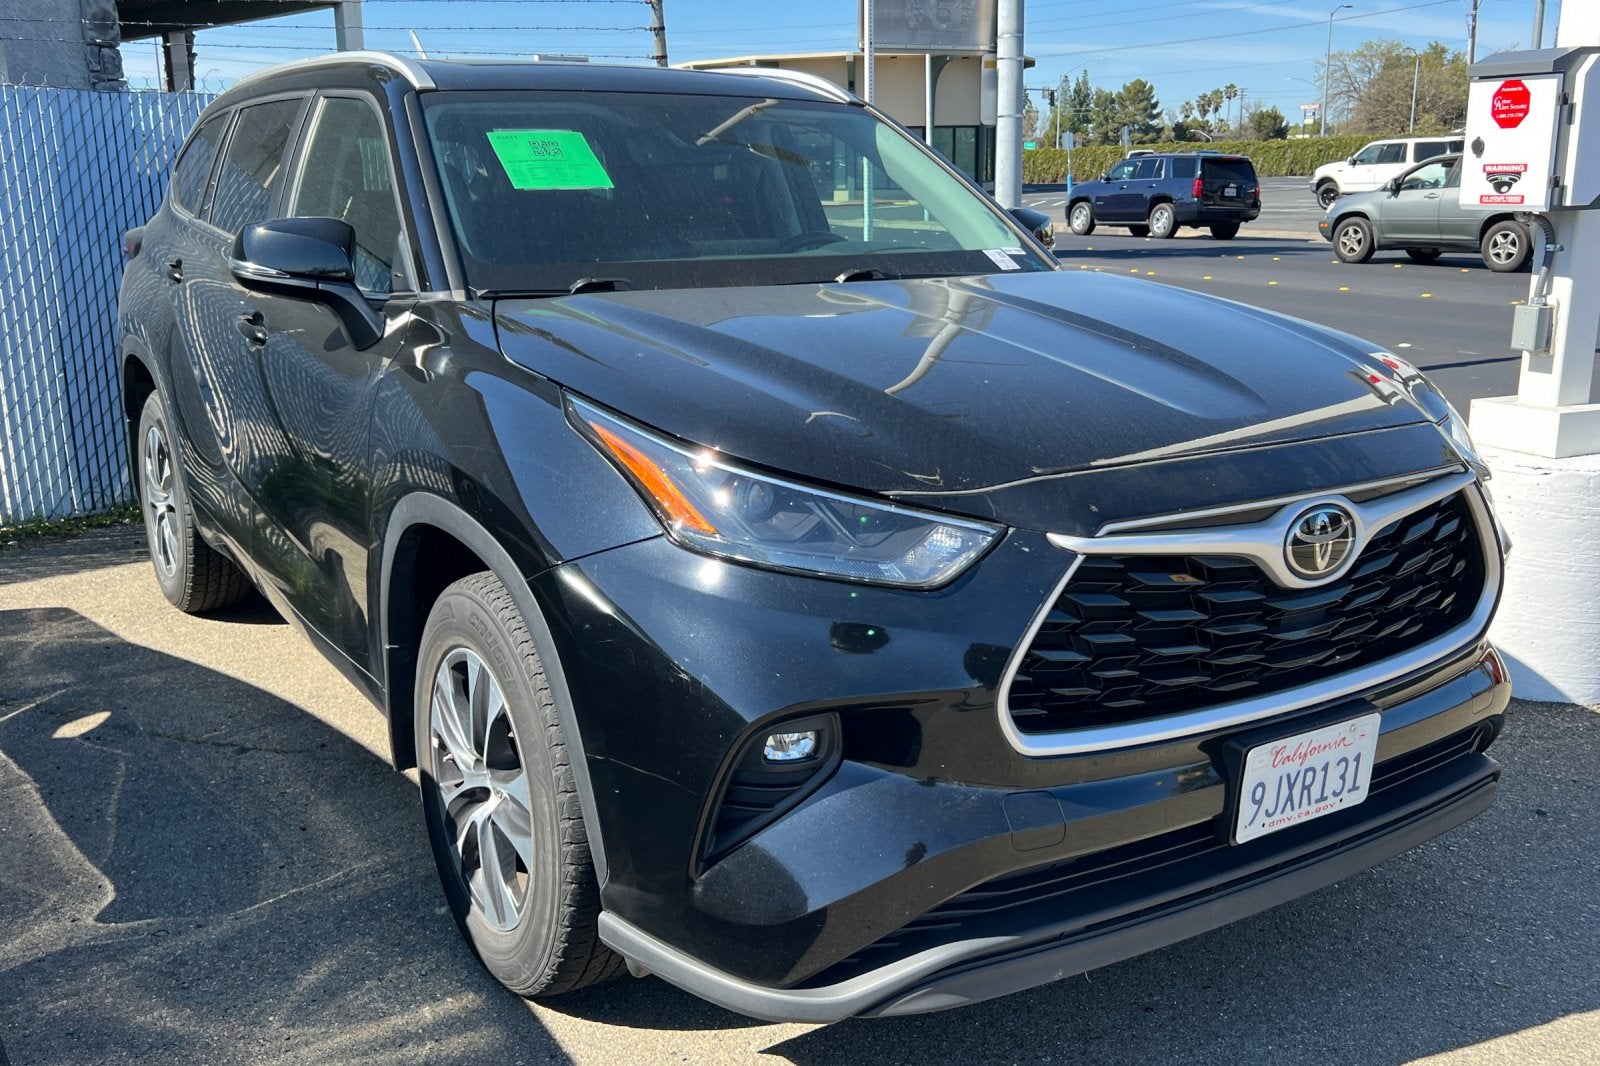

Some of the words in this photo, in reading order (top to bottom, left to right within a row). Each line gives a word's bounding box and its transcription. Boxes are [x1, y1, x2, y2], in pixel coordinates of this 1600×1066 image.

[1271, 733, 1353, 768] California
[1248, 752, 1361, 826] 9JXR131
[1268, 801, 1336, 827] dmv.ca.gov
